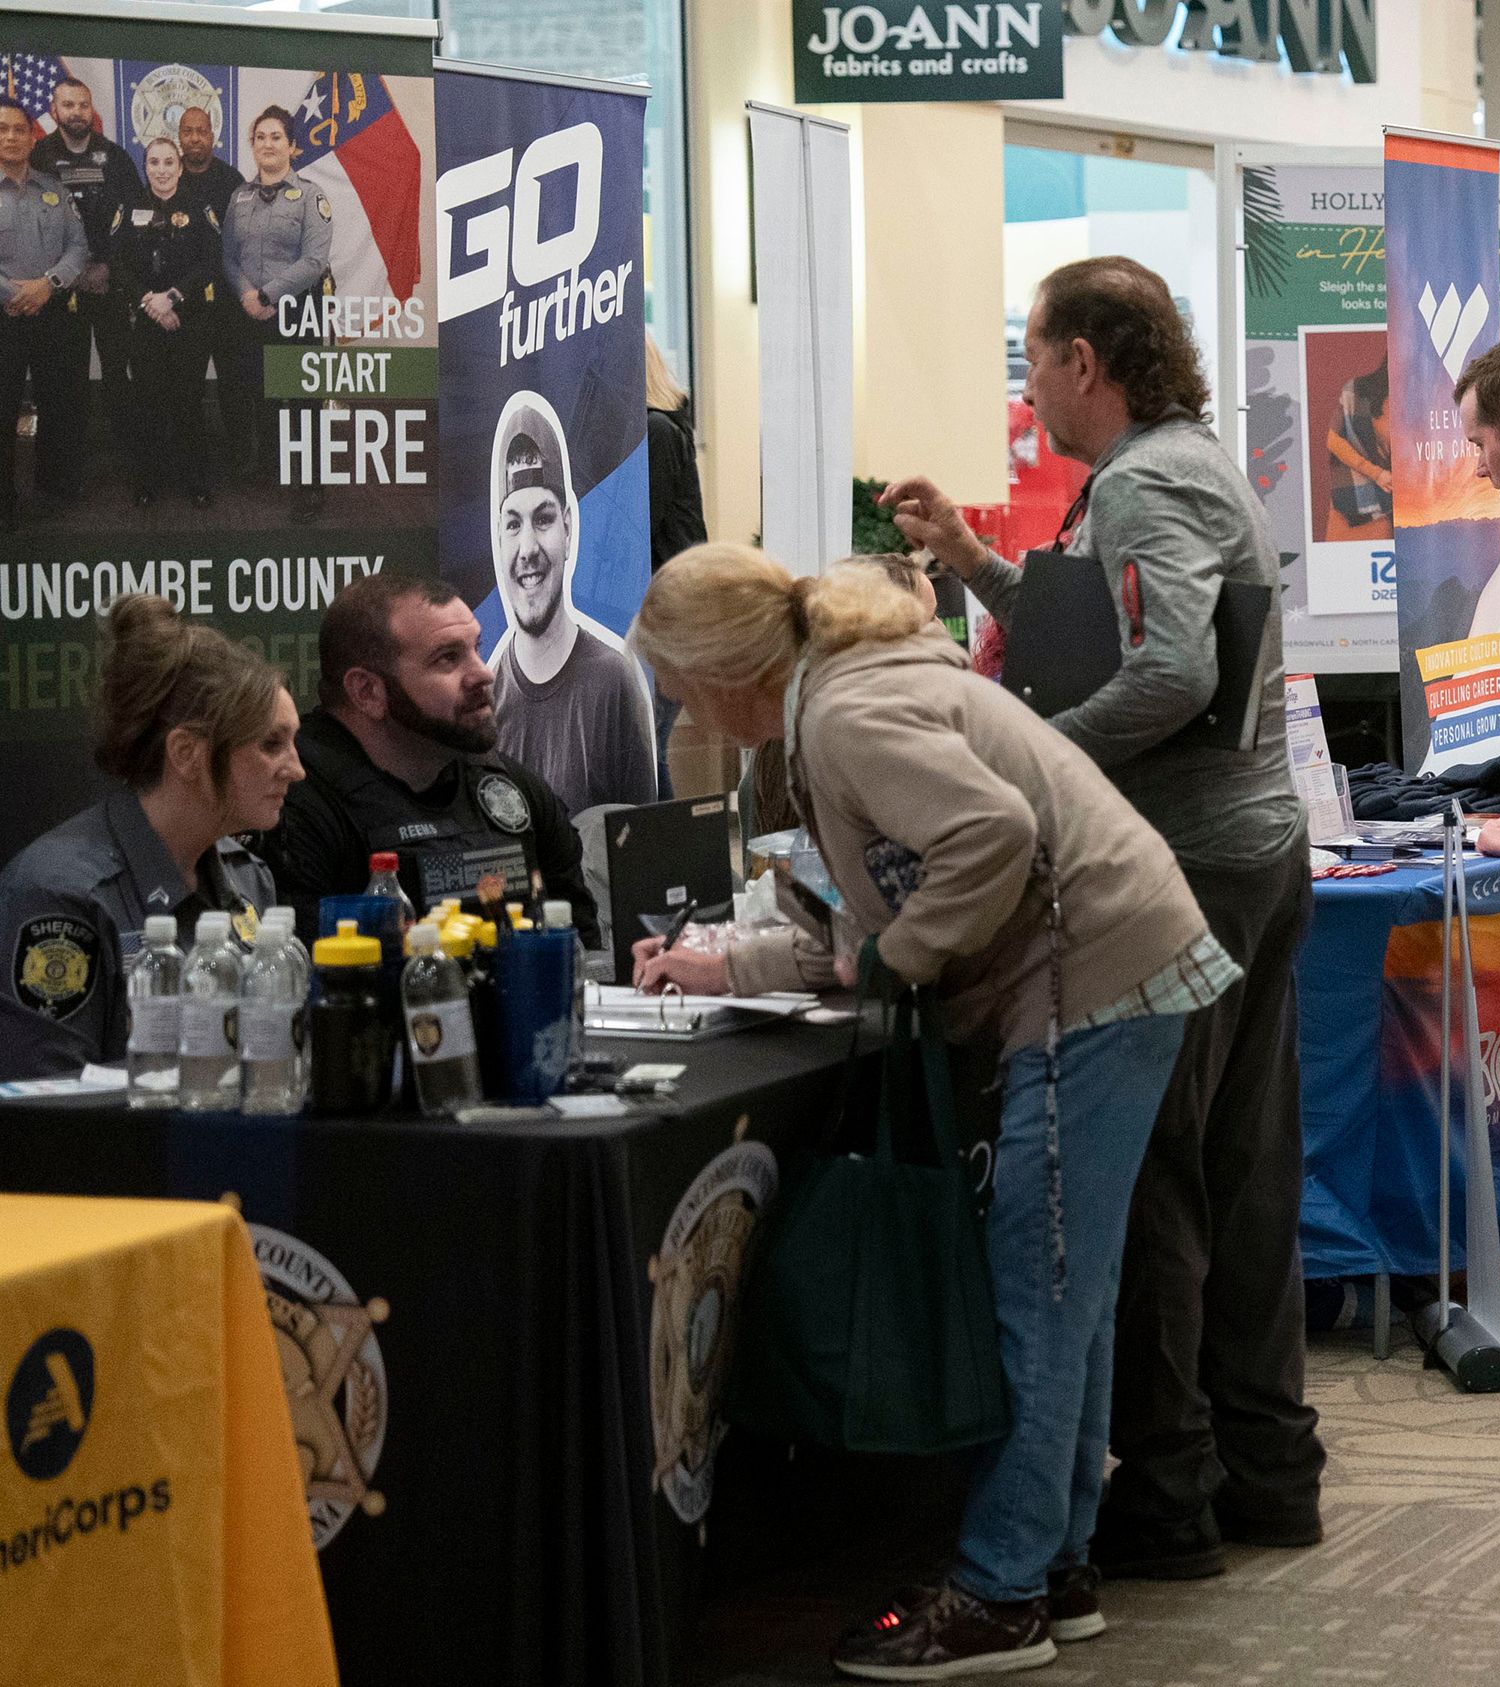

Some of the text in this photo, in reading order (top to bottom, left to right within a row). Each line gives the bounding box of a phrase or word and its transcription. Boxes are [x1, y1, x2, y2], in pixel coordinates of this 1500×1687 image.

[808, 3, 1042, 54] JO-ANN
[822, 50, 1029, 77] fabrics and crafts
[1310, 191, 1385, 211] HOLLY
[436, 122, 604, 324] GO
[1339, 226, 1386, 276] He
[1319, 280, 1354, 296] Sleigh
[1357, 281, 1375, 293] the
[278, 293, 425, 339] CAREERS
[499, 260, 633, 368] further
[1341, 298, 1388, 311] looks fo
[301, 351, 392, 393] START
[279, 408, 428, 485] HERE
[1416, 441, 1444, 461] YOUR
[1429, 689, 1471, 710] FULFILLING
[1434, 724, 1475, 747] PERSONAL
[30, 920, 96, 943] SHERIFF
